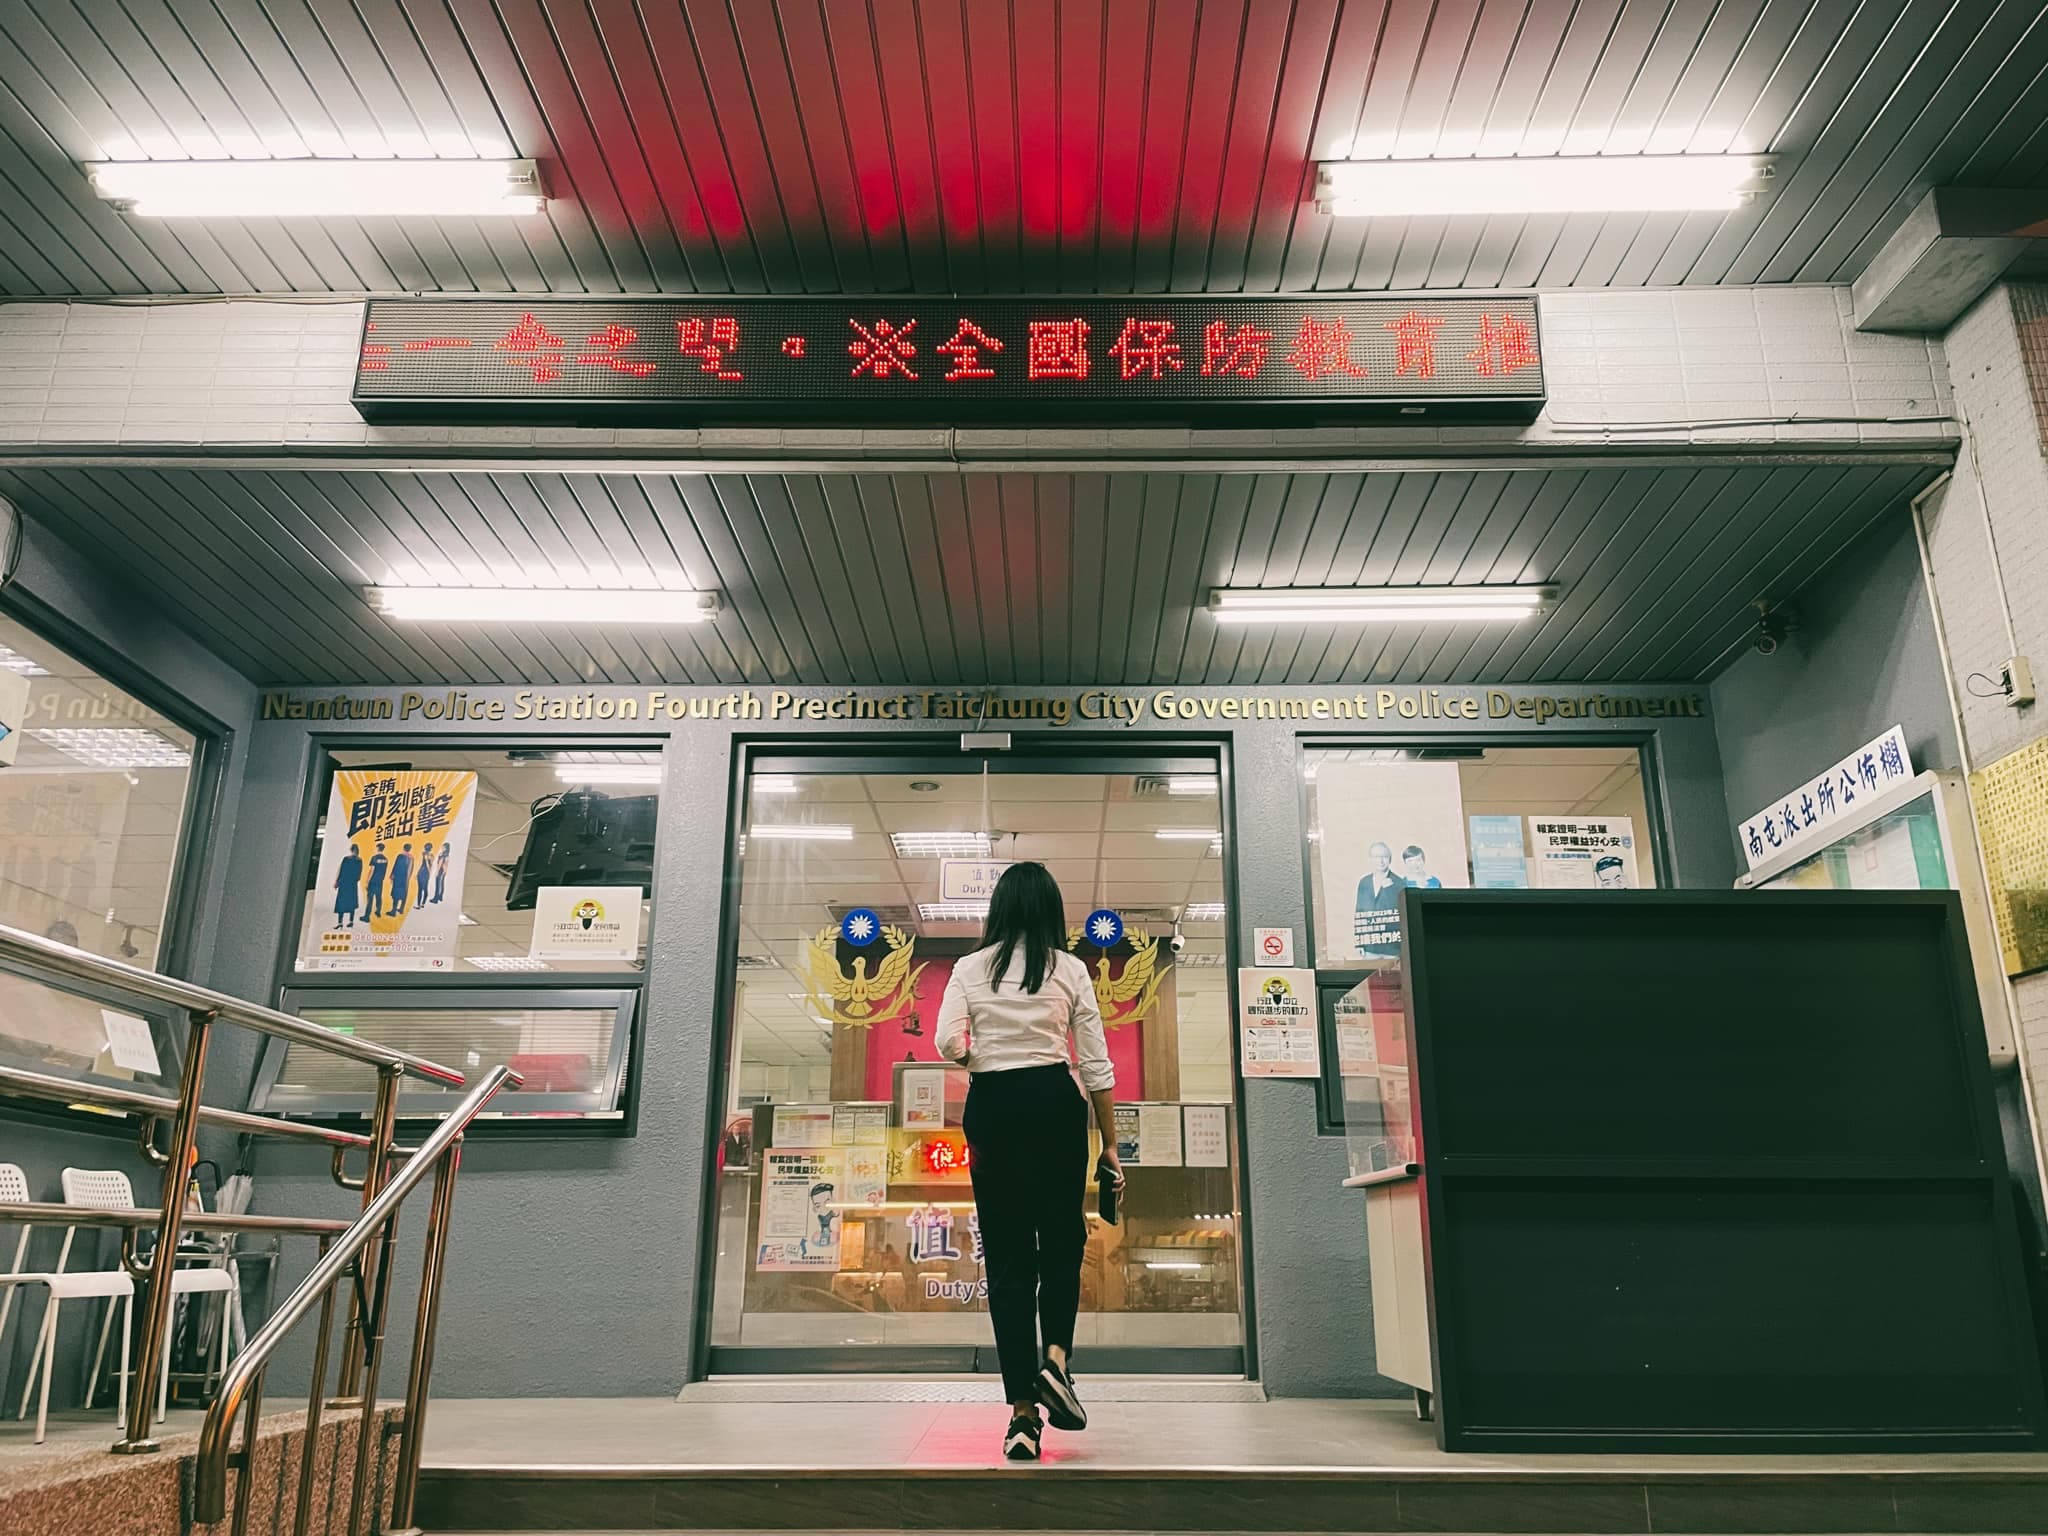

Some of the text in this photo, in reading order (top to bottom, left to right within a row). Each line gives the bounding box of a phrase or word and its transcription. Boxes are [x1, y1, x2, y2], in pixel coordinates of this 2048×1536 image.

[263, 690, 1700, 726] Nantun Police Station Fourth Precinct Taichung City Government Police Department
[362, 778, 397, 800] 查賄
[1749, 736, 1904, 858] 南屯派出所公佈欄
[926, 1279, 974, 1303] Duty
